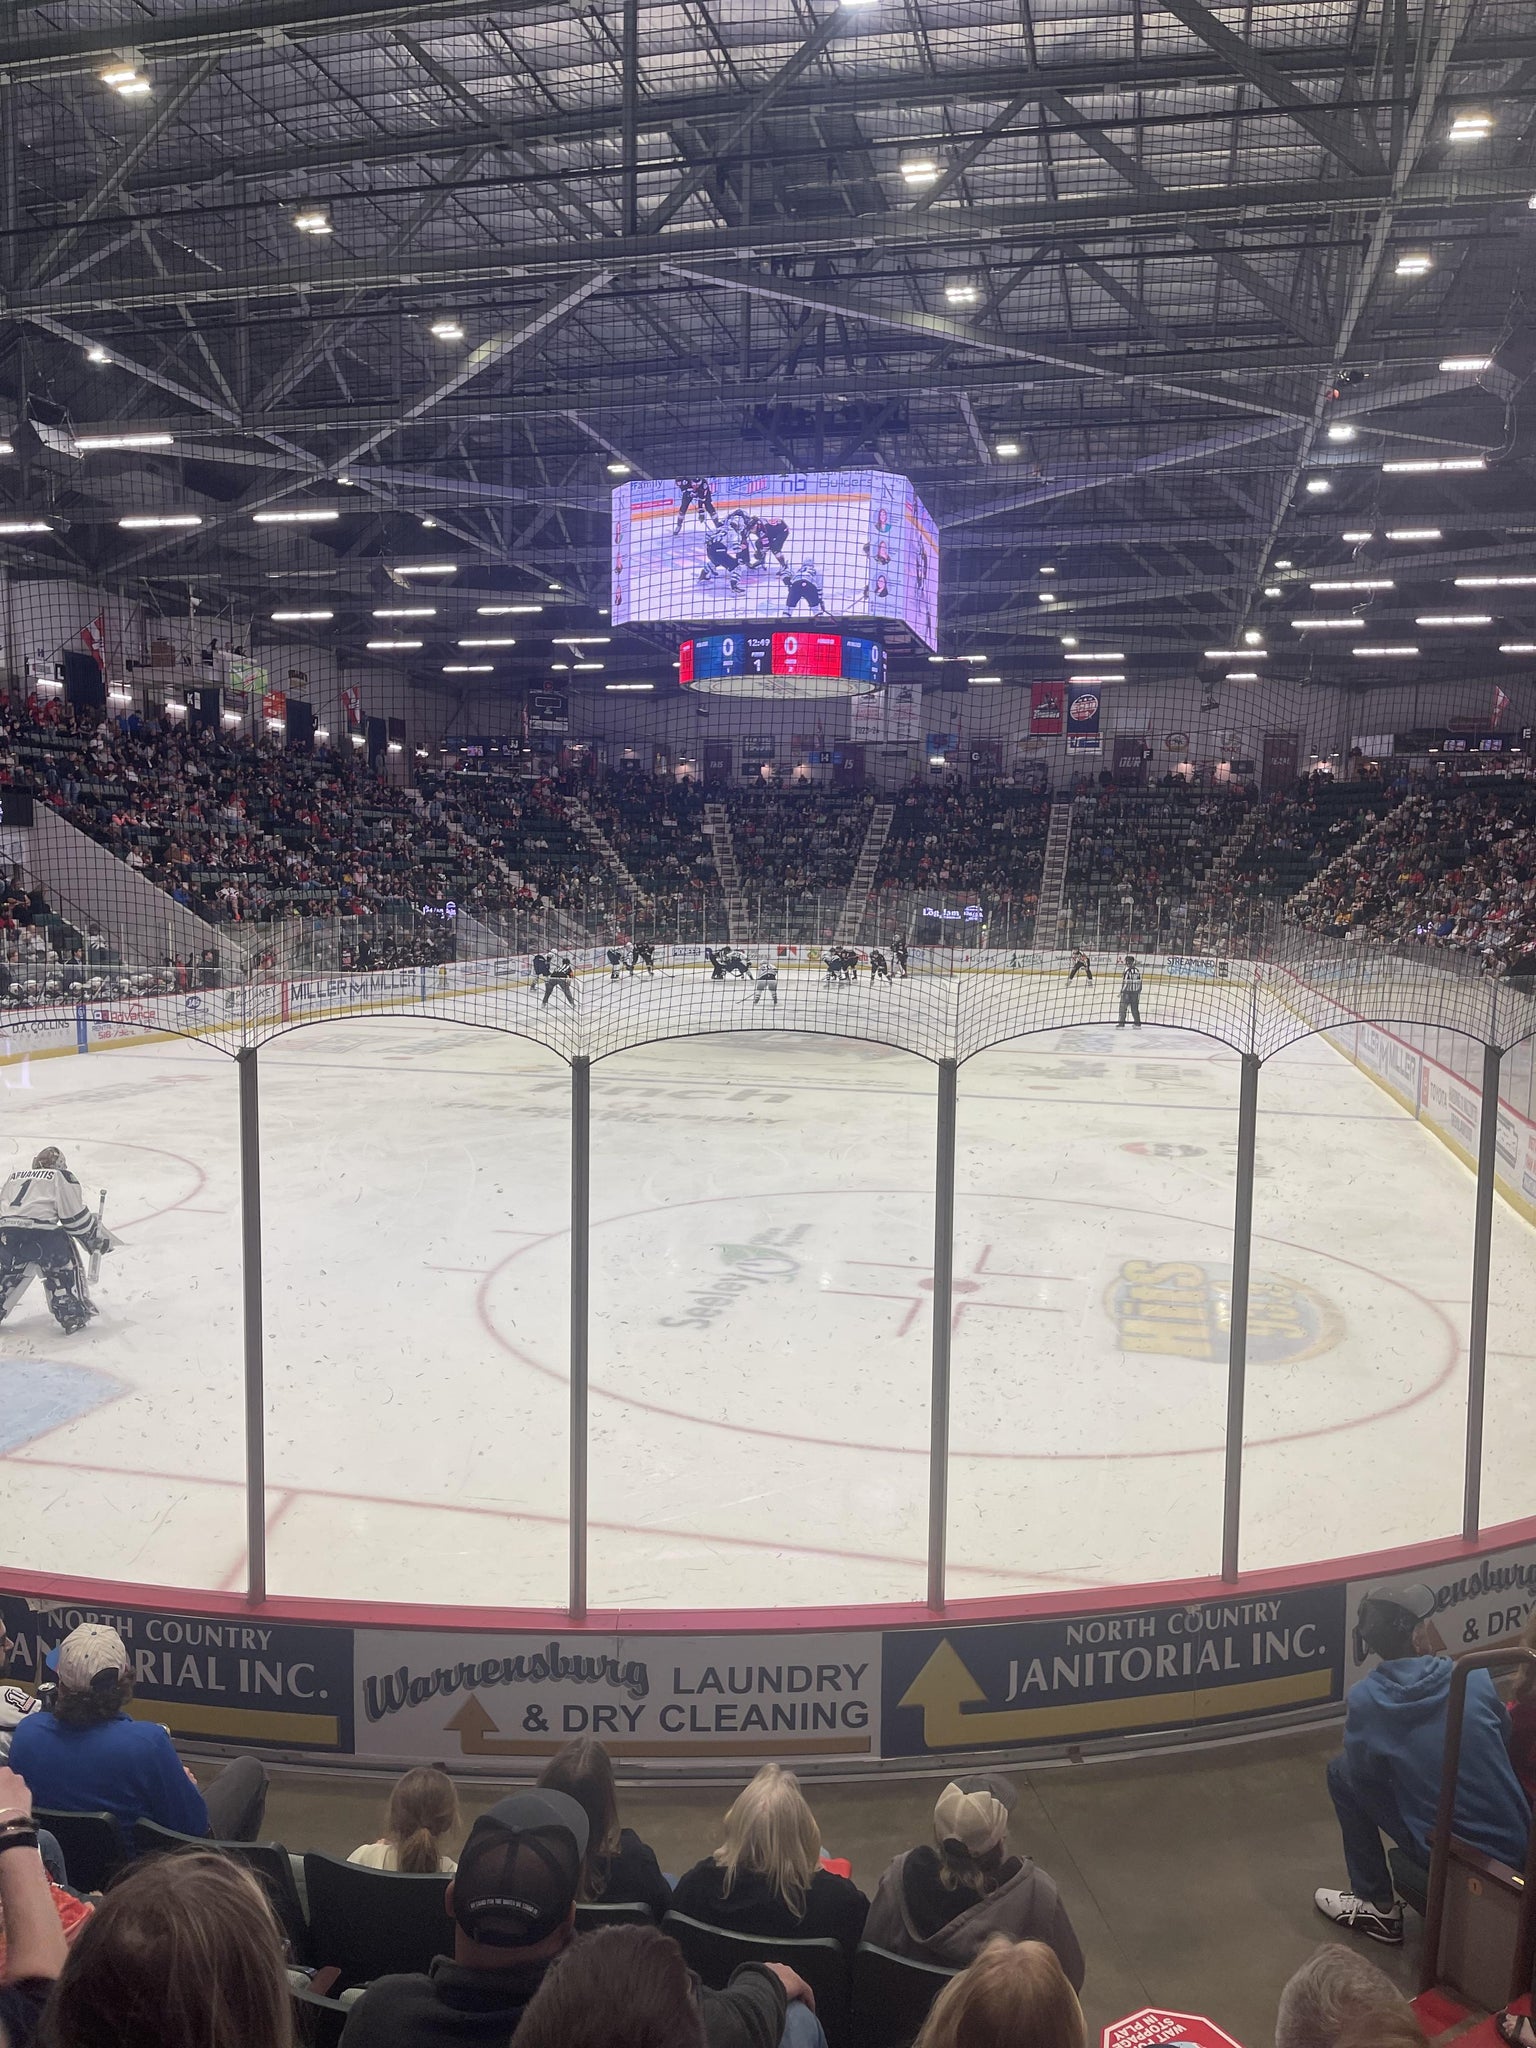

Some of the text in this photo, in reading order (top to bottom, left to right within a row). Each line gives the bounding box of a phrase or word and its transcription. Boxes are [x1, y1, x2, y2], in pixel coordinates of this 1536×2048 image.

[722, 637, 734, 656] 0
[783, 636, 797, 655] 0
[871, 645, 878, 663] 0
[753, 659, 761, 672] 1
[1118, 757, 1141, 768] OUR
[290, 979, 347, 1000] MILLER
[10, 1178, 33, 1207] 1
[145, 1619, 273, 1651] COUNTRY
[1066, 1600, 1282, 1646] NORTH COUNTRY
[1462, 1617, 1480, 1643] &
[1004, 1623, 1326, 1702] JANITORIAL INC.
[240, 1658, 328, 1699] INC.
[363, 1642, 869, 1723] Warrensburg LAUNDRY
[522, 1700, 870, 1733] & DRY CLEANING
[1111, 2017, 1175, 2048] STOPPAGE
[1113, 2014, 1159, 2041] IN PLAY
[1156, 2023, 1188, 2043] WAIT
